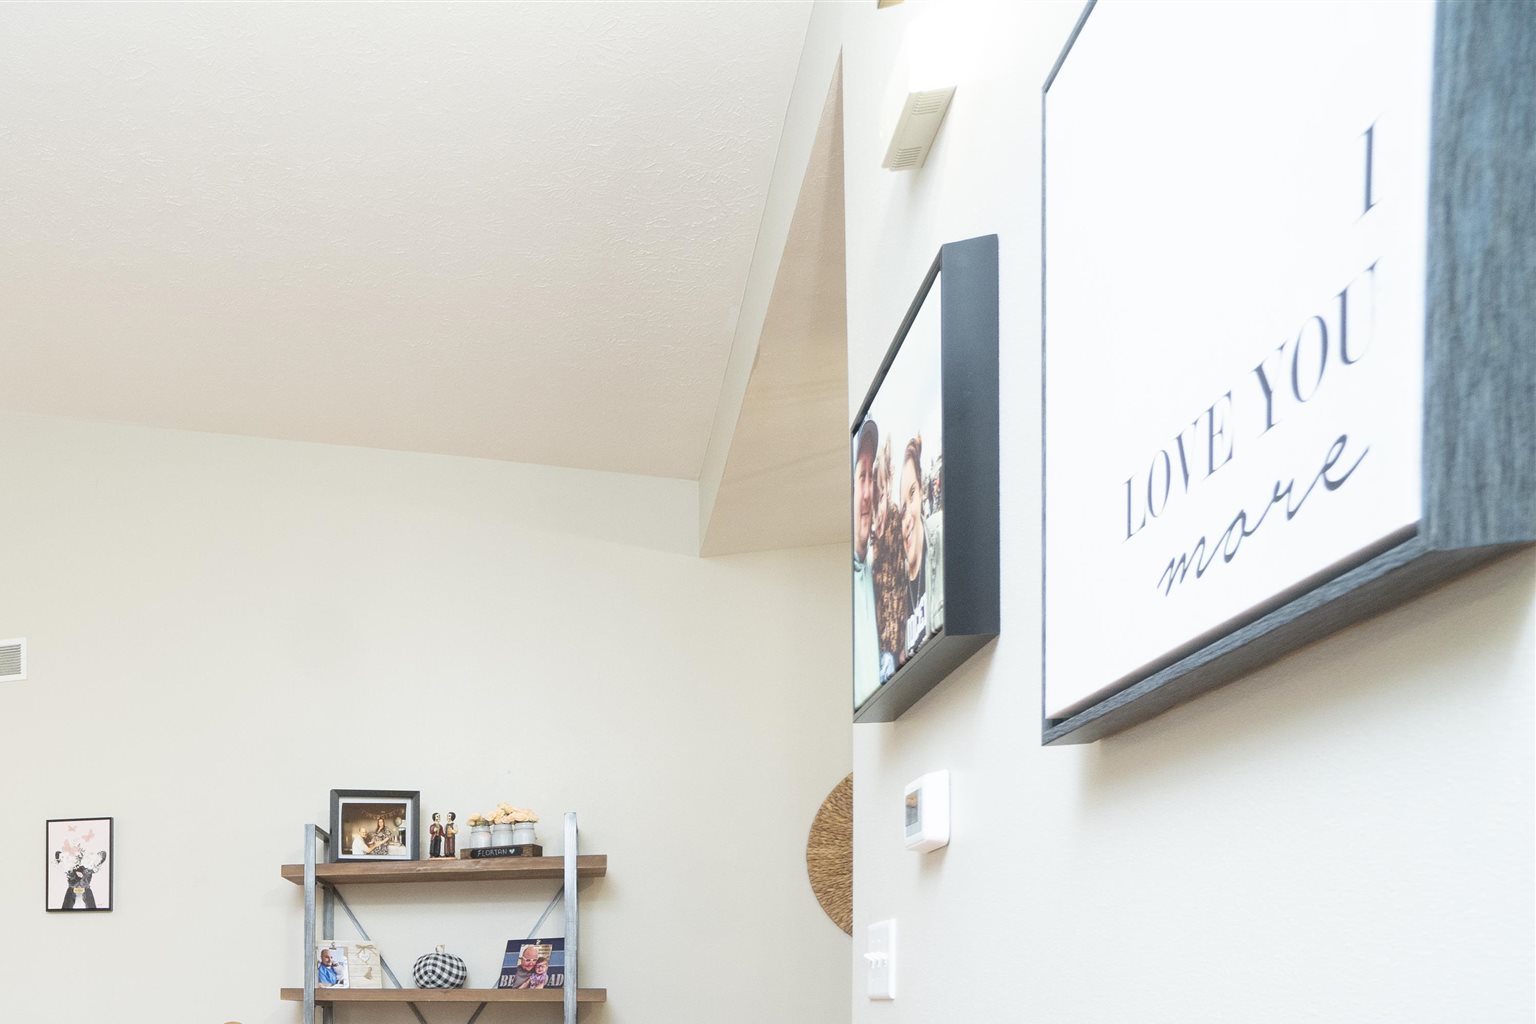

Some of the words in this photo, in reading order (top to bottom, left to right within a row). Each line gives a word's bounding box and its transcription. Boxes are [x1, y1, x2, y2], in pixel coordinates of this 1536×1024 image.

[1353, 112, 1384, 224] I
[1121, 390, 1235, 544] LOVE
[1249, 257, 1383, 438] YOU
[1157, 433, 1371, 598] more
[477, 848, 508, 857] FLORIAN
